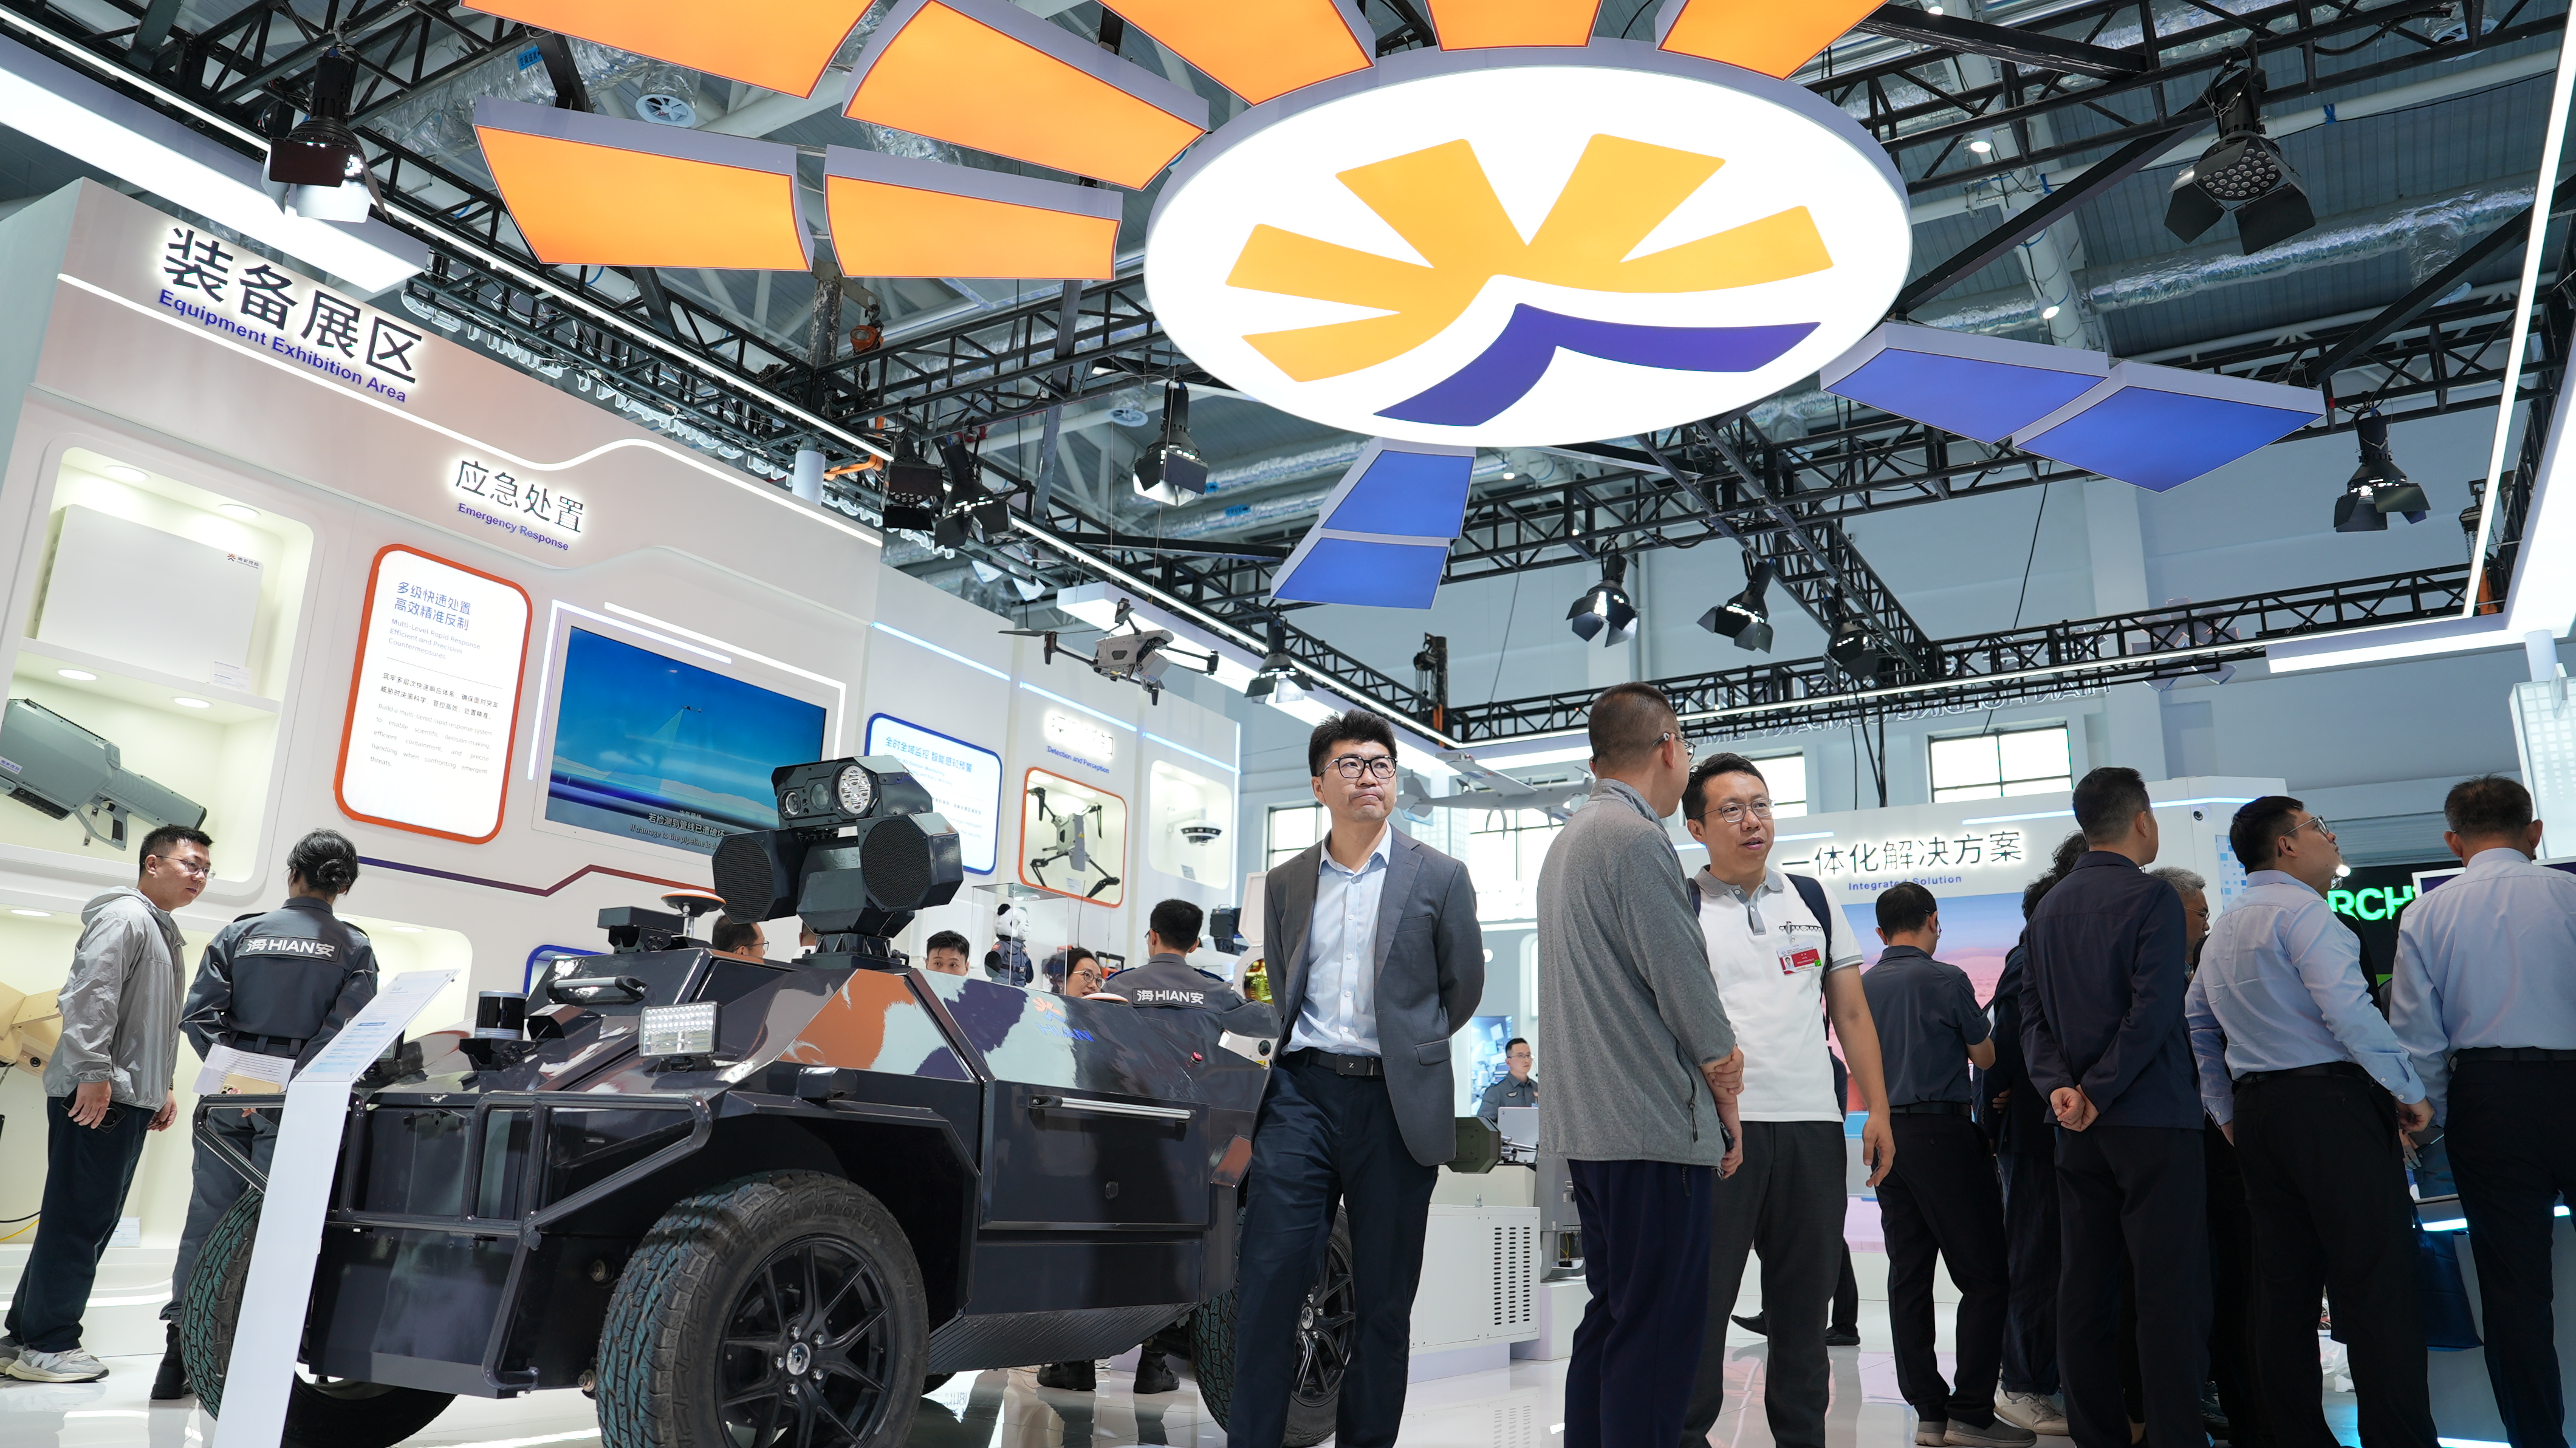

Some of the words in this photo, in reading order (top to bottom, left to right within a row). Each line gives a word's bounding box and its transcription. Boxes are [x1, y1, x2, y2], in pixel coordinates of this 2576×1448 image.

[162, 227, 422, 384] 装备展区
[158, 289, 266, 346] Equipment
[272, 336, 362, 385] Exhibition
[366, 377, 406, 403] Area
[455, 460, 583, 533] 应急处置
[457, 502, 517, 533] Emergency
[519, 525, 569, 551] Response
[397, 581, 471, 615] 多级快速处置
[394, 597, 470, 631] 高效精准反制
[388, 638, 446, 660] Countermeasures
[389, 628, 417, 641] Efficient
[419, 637, 431, 646] and
[433, 641, 462, 654] Precision
[391, 618, 430, 635] Multi-Level
[430, 630, 449, 641] Rapid
[450, 636, 481, 650] Response
[374, 730, 397, 740] efficient
[379, 703, 393, 712] Build
[433, 718, 448, 727] rapid
[448, 722, 473, 733] response
[474, 728, 493, 736] system
[388, 720, 408, 729] enable
[414, 728, 439, 737] scientific
[371, 743, 398, 756] handling
[403, 751, 419, 760] when
[424, 757, 456, 770] confronting
[461, 765, 488, 774] emergent
[885, 737, 930, 759] 全时全域监控
[1047, 745, 1072, 760] Detection
[1083, 759, 1110, 774] Perception
[635, 825, 661, 838] damage
[670, 833, 680, 842] the
[680, 835, 704, 847] pipeline
[1781, 830, 2023, 876] 一体化解决方案
[1912, 874, 1962, 886] Solution
[1035, 1022, 1095, 1043] HIAN
